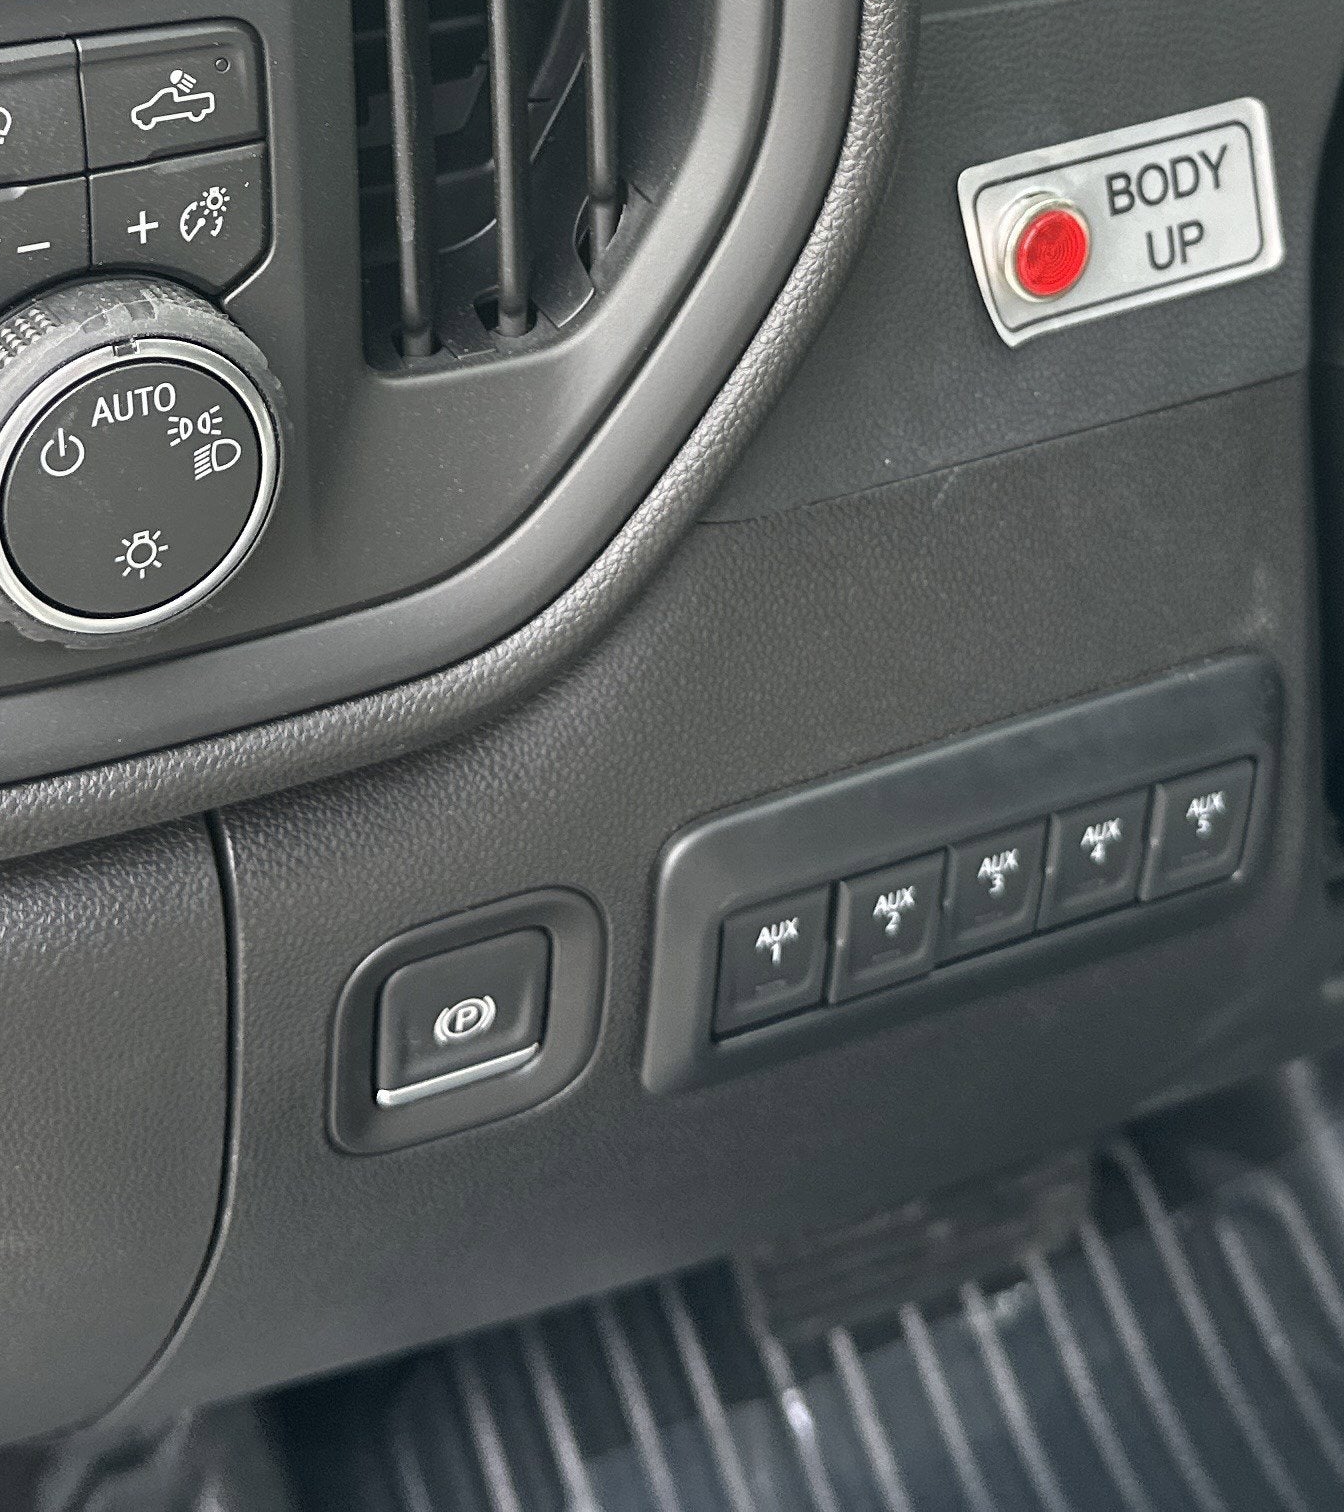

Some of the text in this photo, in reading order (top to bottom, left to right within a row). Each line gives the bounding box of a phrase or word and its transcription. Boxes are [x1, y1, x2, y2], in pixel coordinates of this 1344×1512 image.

[1105, 144, 1228, 217] BODY
[1145, 219, 1205, 271] UP
[90, 381, 177, 428] AUTO
[1185, 790, 1228, 821] AUX
[1080, 817, 1122, 849] AUX
[1194, 813, 1212, 837] 5
[977, 848, 1019, 881] AUX
[1090, 841, 1107, 866] 4
[988, 872, 1005, 897] 3
[872, 885, 915, 920] AUX
[756, 916, 798, 951] AUX
[884, 910, 902, 936] 2
[770, 943, 782, 964] 1
